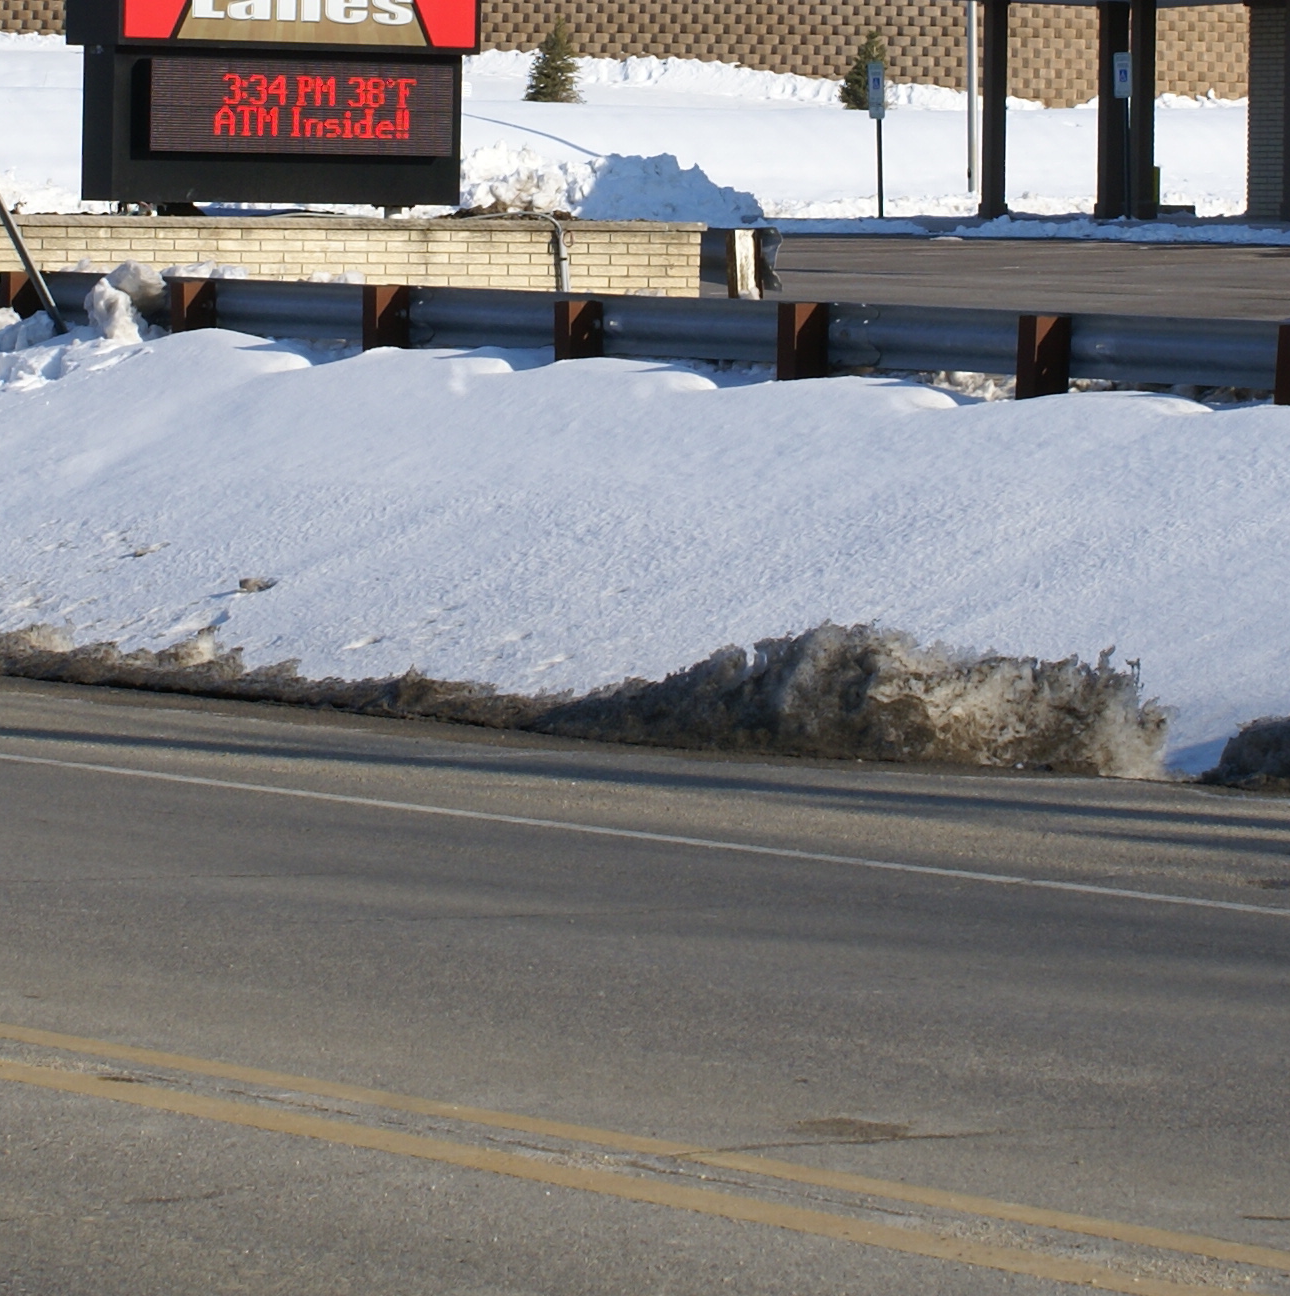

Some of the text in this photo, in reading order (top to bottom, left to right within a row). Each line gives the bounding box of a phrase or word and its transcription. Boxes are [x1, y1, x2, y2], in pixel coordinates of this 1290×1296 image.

[223, 73, 287, 106] 3:34
[296, 75, 336, 107] PM
[213, 105, 410, 140] ATM Inside!!
